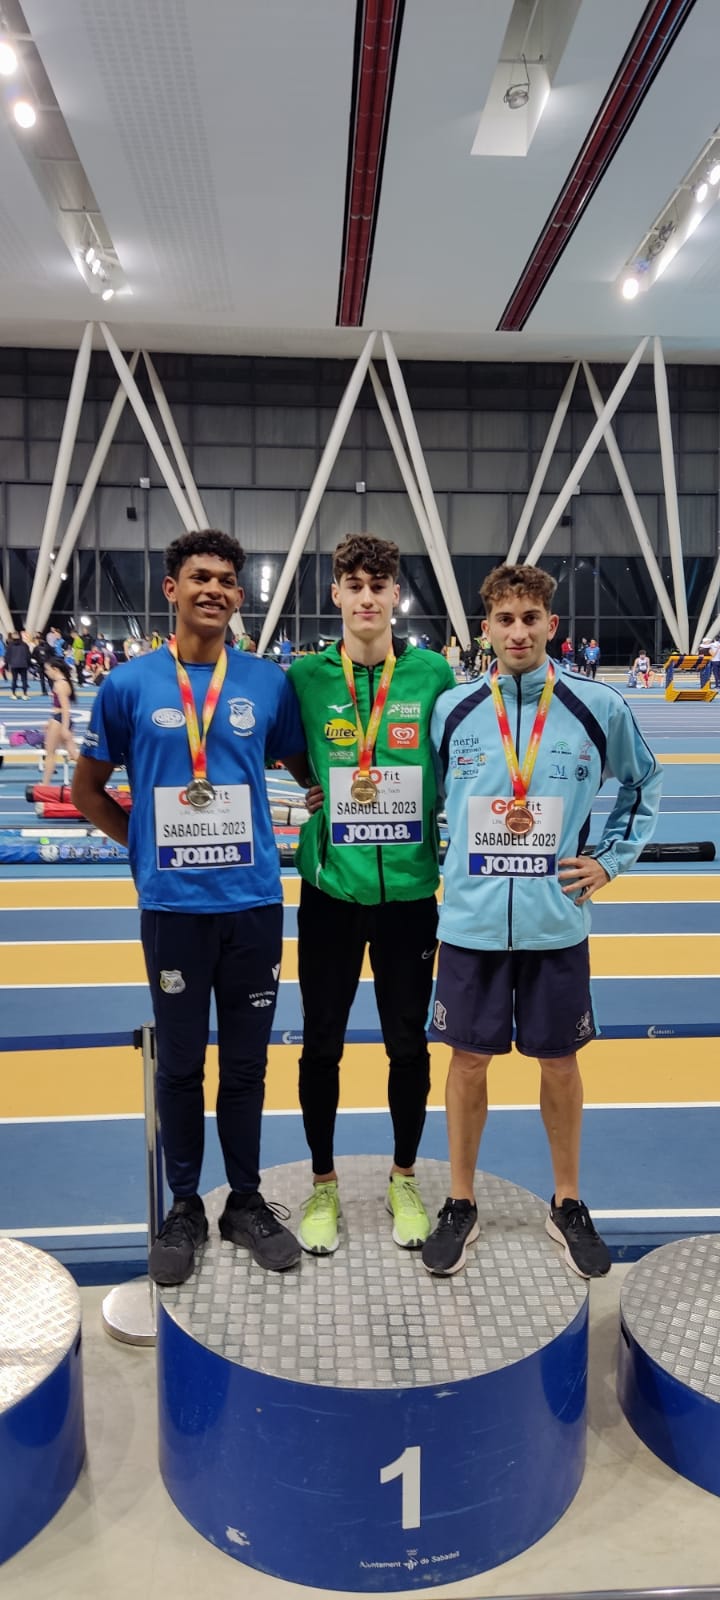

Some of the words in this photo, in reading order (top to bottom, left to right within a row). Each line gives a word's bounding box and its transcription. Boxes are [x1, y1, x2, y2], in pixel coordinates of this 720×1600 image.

[453, 735, 480, 747] nerja
[384, 770, 400, 781] fit
[336, 802, 389, 815] SABADELL
[392, 801, 417, 815] 2023
[526, 801, 542, 811] fit
[163, 822, 220, 838] SABADELL
[222, 821, 246, 836] 2023
[343, 824, 411, 843] Joma
[475, 832, 530, 846] SABADELL
[532, 833, 557, 847] 2023
[170, 845, 241, 867] Joma
[481, 855, 549, 875] Joma
[380, 1446, 421, 1529] 1
[431, 1551, 460, 1563] Sabadell
